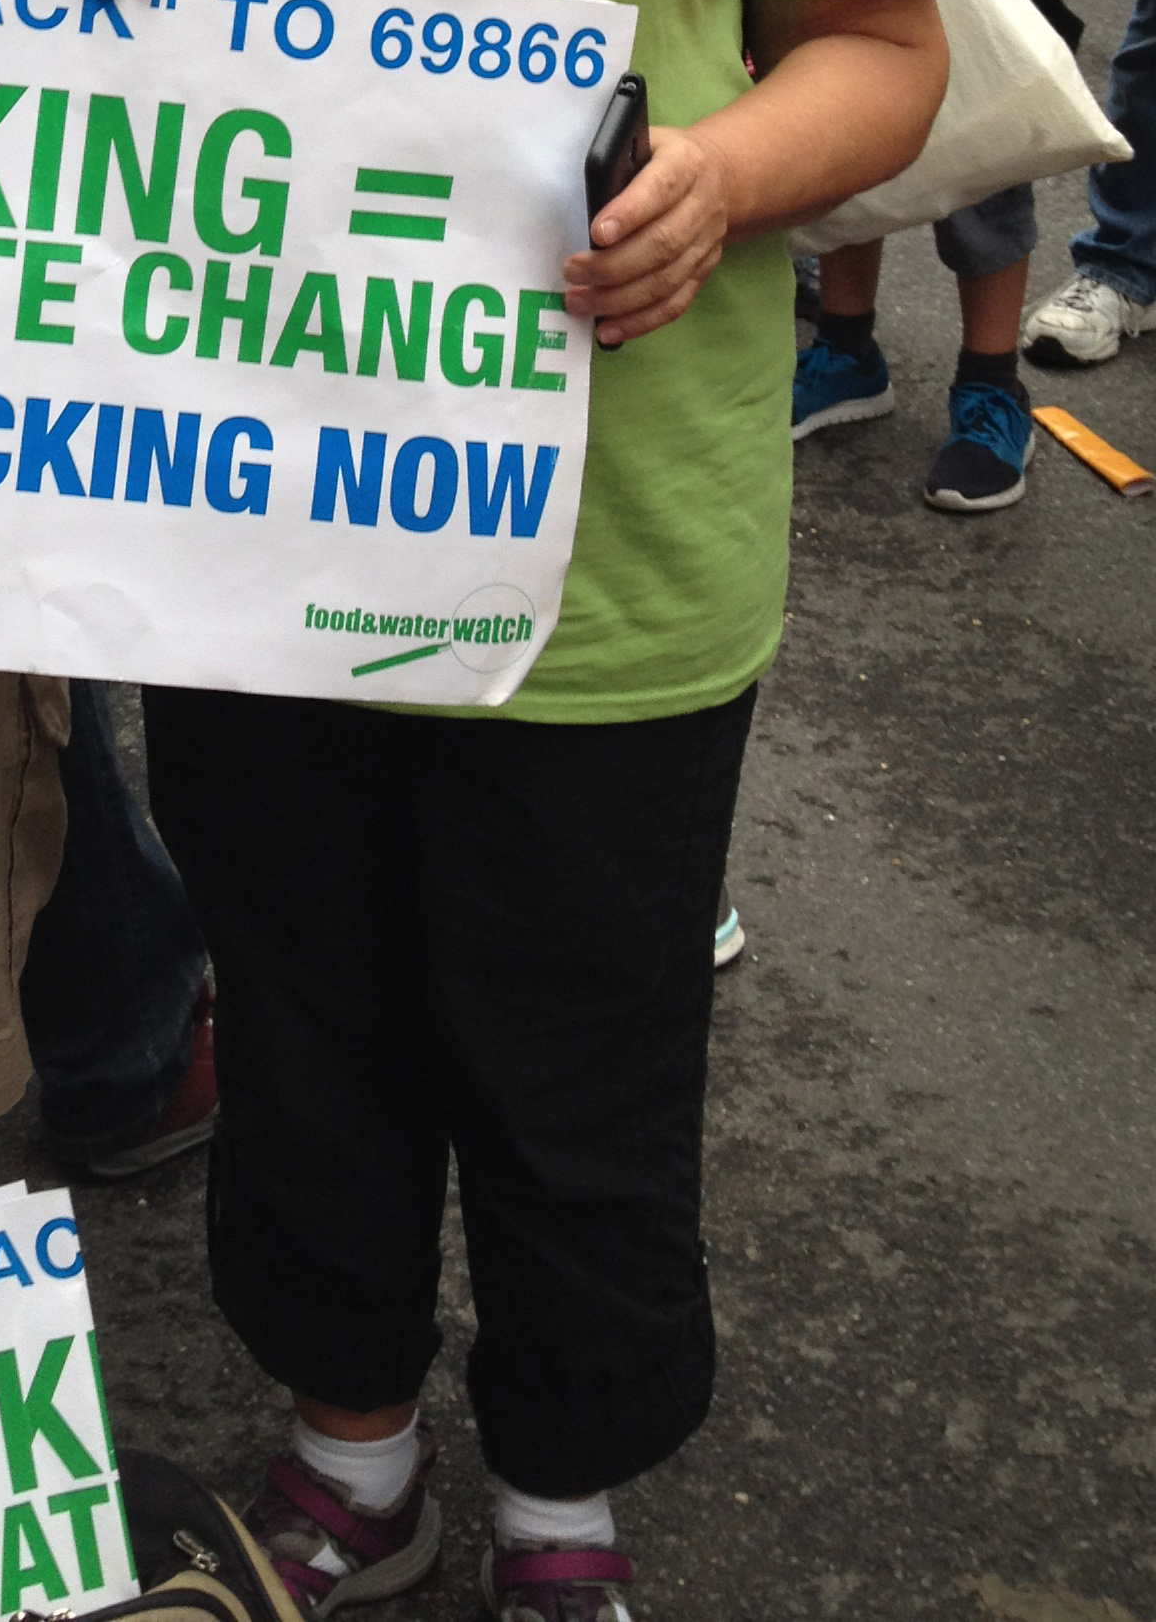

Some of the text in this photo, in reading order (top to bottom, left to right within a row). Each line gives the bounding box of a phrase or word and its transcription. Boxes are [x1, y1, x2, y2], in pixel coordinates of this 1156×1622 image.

[371, 8, 607, 90] 69866
[121, 252, 567, 392] CHANGE
[311, 426, 560, 539] NOW
